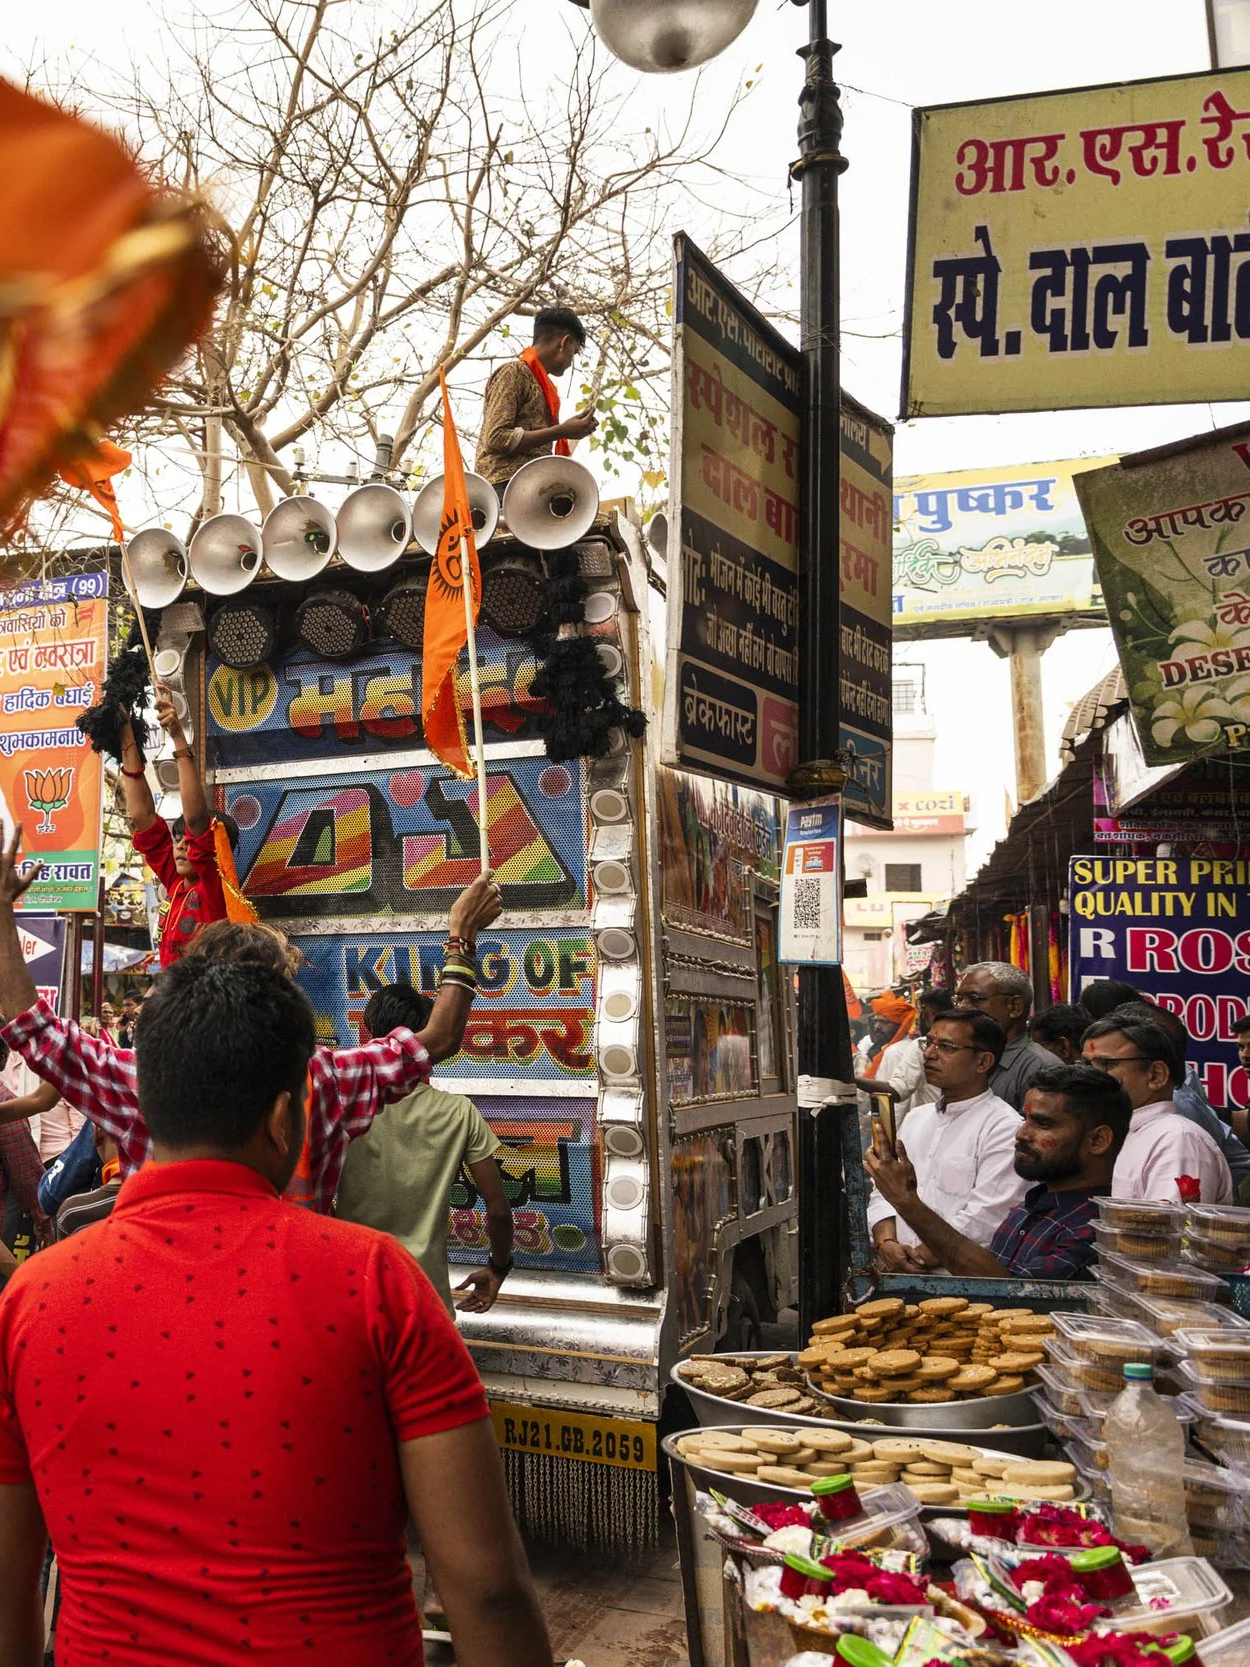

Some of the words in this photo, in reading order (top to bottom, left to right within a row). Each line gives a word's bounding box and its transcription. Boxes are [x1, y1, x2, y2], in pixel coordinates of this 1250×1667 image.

[955, 90, 1250, 196] आर.एस.रे
[700, 441, 760, 522] दाल
[914, 478, 1057, 533] पुष्कर
[8, 641, 31, 672] एवं
[5, 688, 51, 712] हार्दिक
[214, 670, 271, 718] VIP
[683, 672, 755, 746] ब्रेकफास्ट
[915, 795, 955, 812] cozi
[54, 863, 92, 880] रावत
[1074, 860, 1178, 885] SUPER
[1191, 860, 1250, 885] PRI
[1074, 891, 1196, 920] QUALITY
[1207, 892, 1237, 917] IN
[1079, 928, 1116, 959] R
[523, 937, 596, 998] OF
